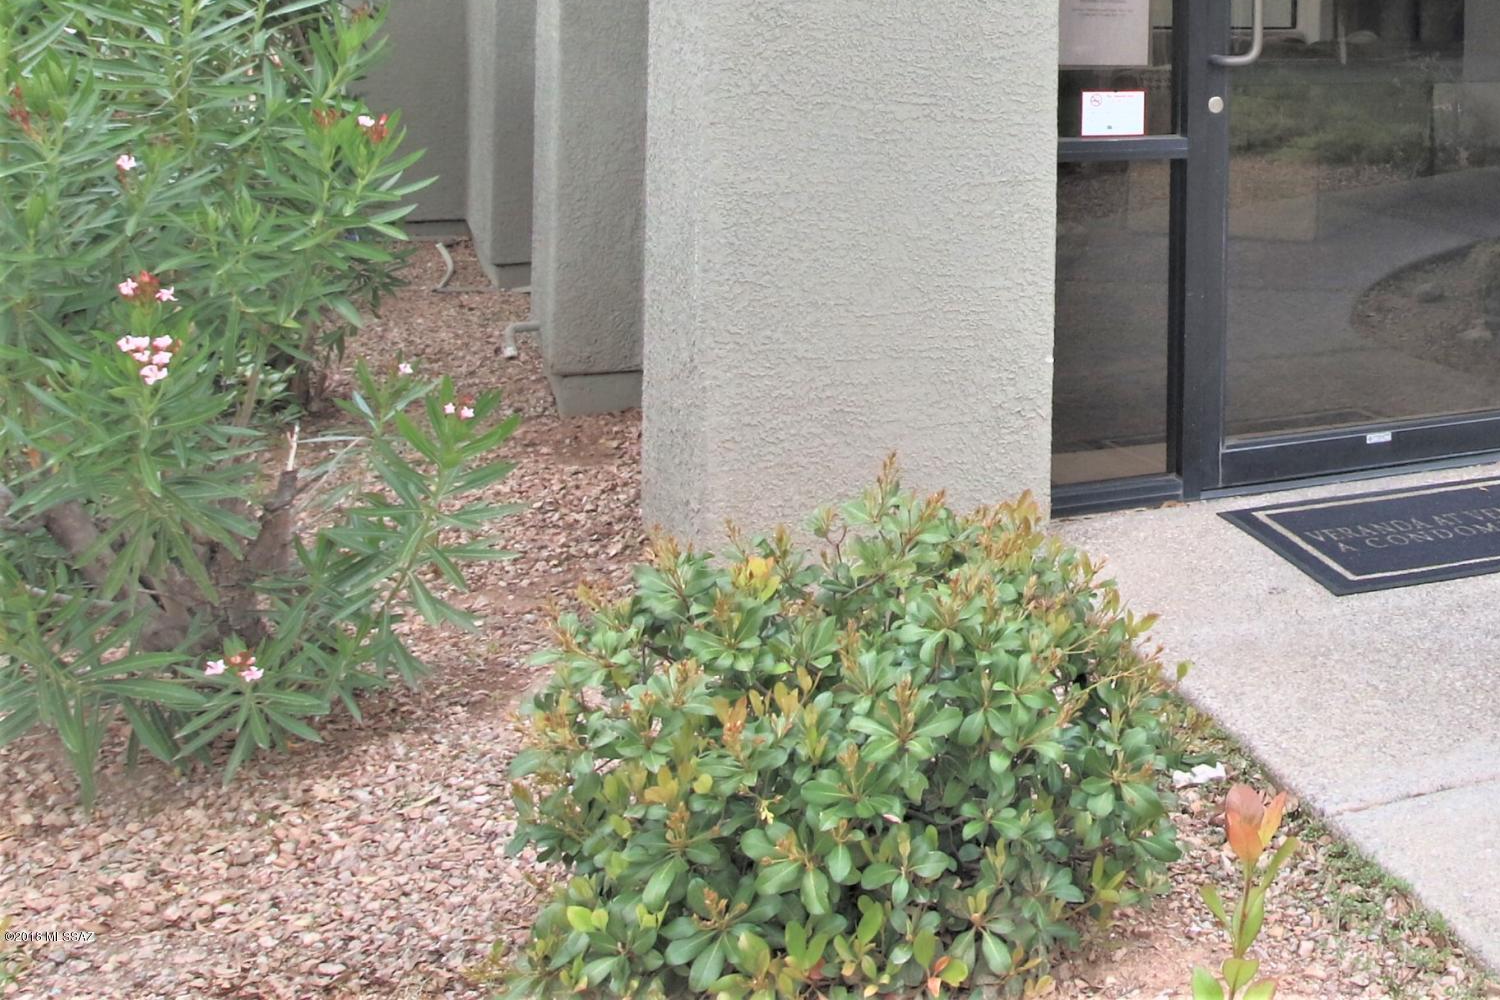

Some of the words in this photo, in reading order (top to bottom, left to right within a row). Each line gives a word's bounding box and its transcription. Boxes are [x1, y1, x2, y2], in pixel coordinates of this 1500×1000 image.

[1304, 517, 1427, 543] VERANDA
[1431, 511, 1459, 528] AT
[1338, 541, 1358, 554] A
